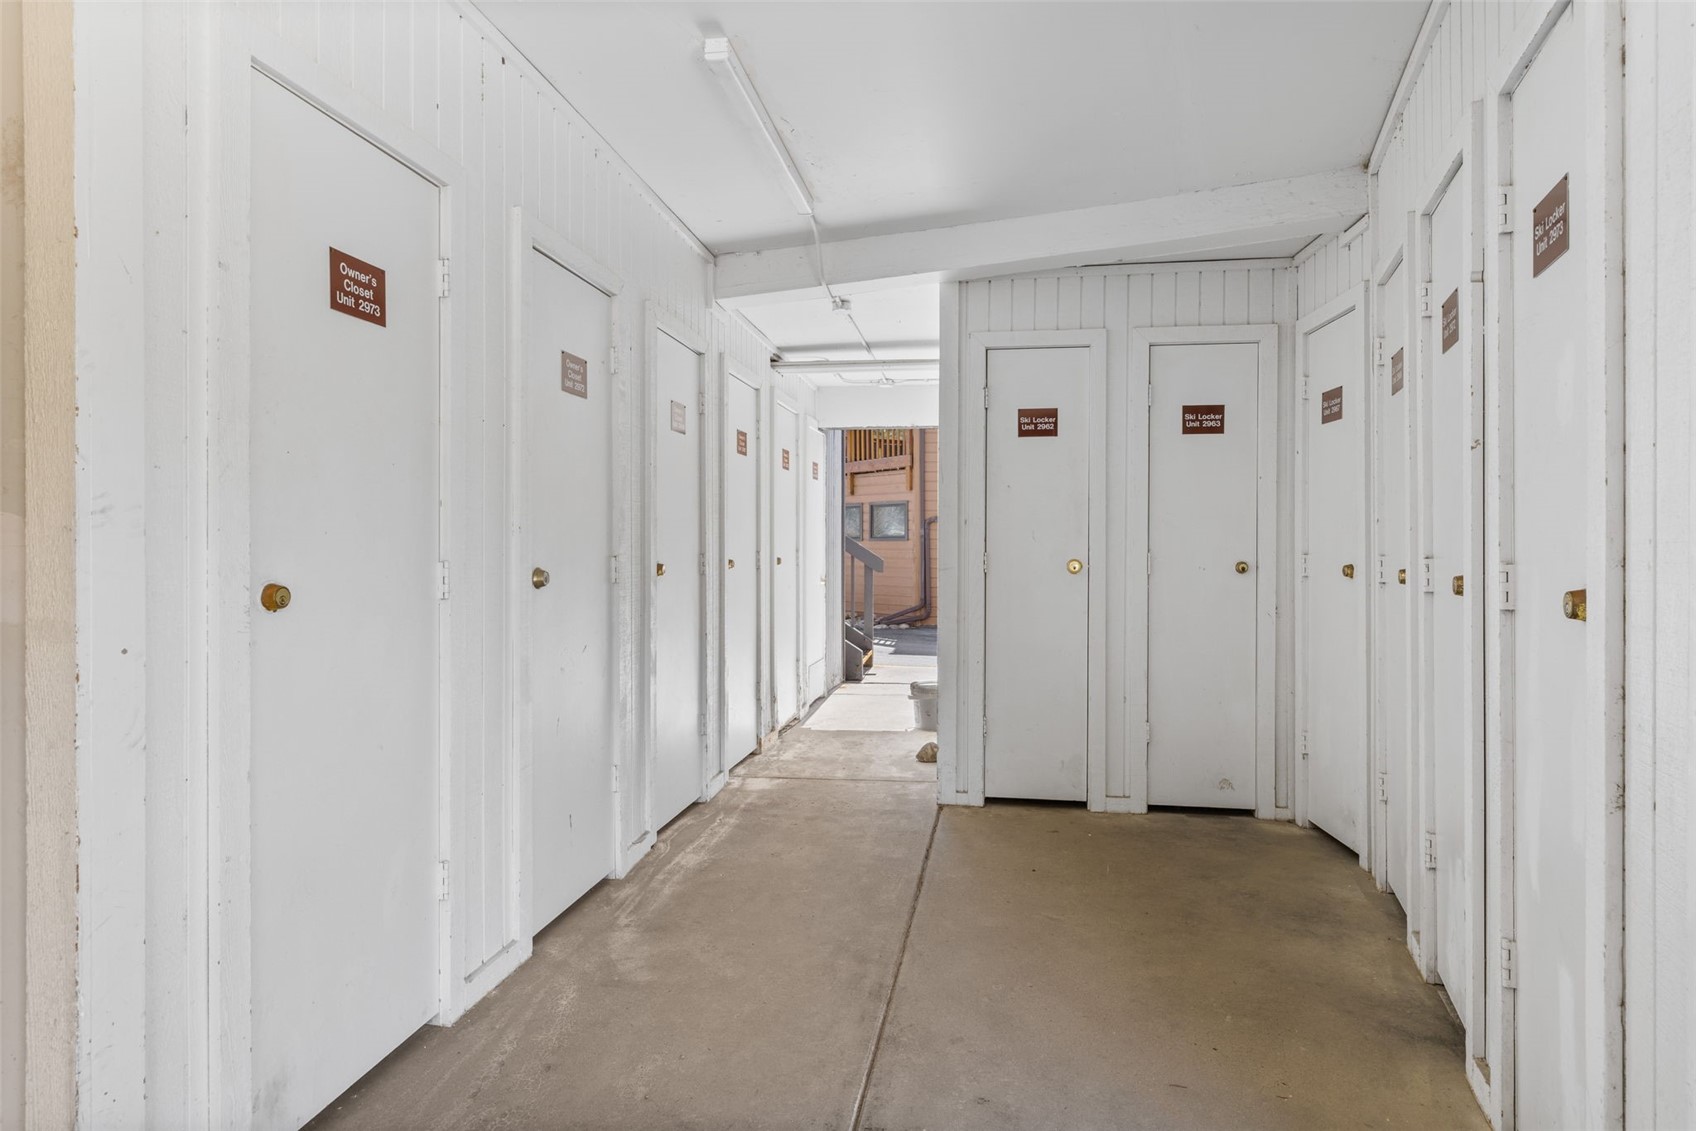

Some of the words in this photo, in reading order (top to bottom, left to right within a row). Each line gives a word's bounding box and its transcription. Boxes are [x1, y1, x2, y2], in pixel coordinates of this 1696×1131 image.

[1535, 220, 1544, 240] Ski
[1545, 202, 1565, 230] Locker
[1536, 236, 1548, 256] Unit
[1549, 220, 1564, 245] 2973
[340, 262, 377, 287] Owner's
[343, 279, 373, 300] Closet
[336, 291, 355, 308] Unit
[358, 299, 381, 317] 2973
[565, 358, 584, 373] Owner's
[567, 369, 582, 382] Closet
[564, 377, 574, 388] Unit
[1020, 416, 1031, 424] Ski
